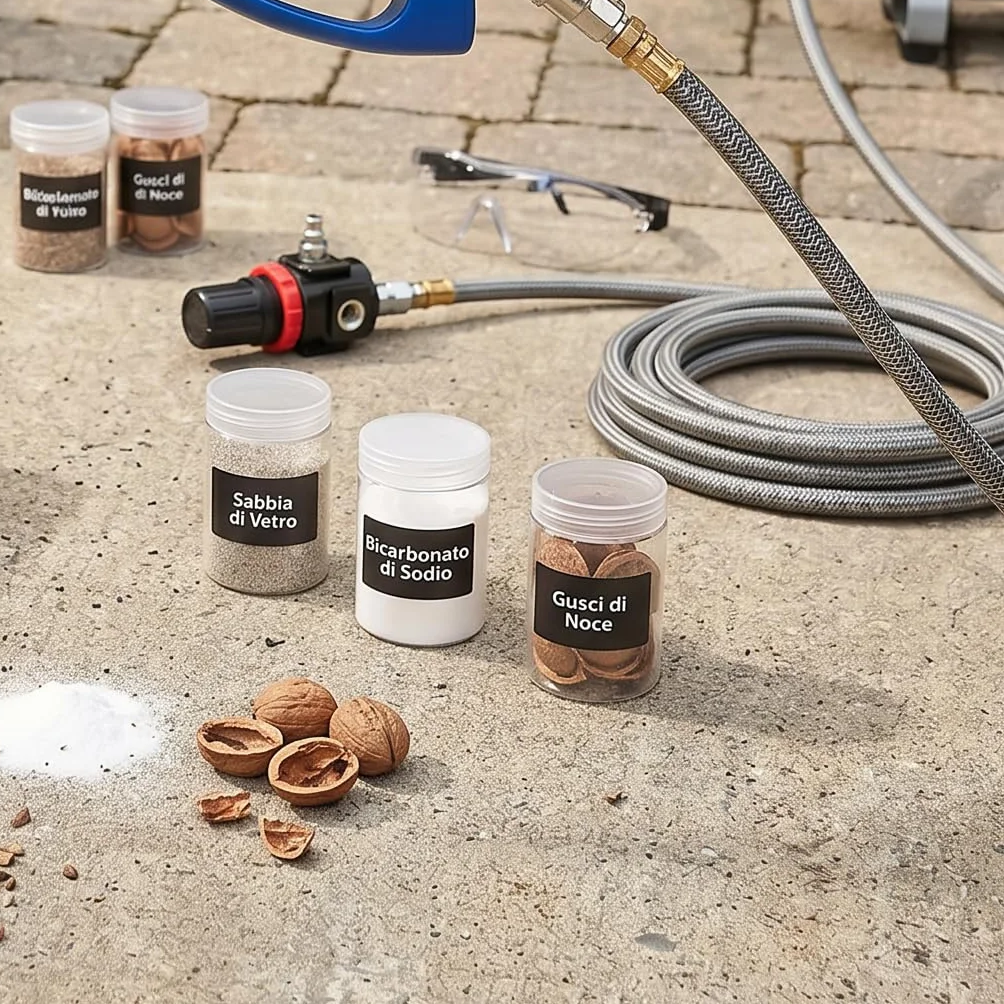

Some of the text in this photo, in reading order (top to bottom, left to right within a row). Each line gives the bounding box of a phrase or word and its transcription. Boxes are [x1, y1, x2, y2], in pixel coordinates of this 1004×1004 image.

[149, 189, 184, 201] Noce
[232, 492, 293, 511] Sabbia
[229, 511, 297, 530] di Vetro
[365, 534, 470, 563] Bicarbonato
[380, 560, 453, 582] di Sodio
[552, 591, 627, 612] Gusci di
[565, 612, 614, 632] Noce
